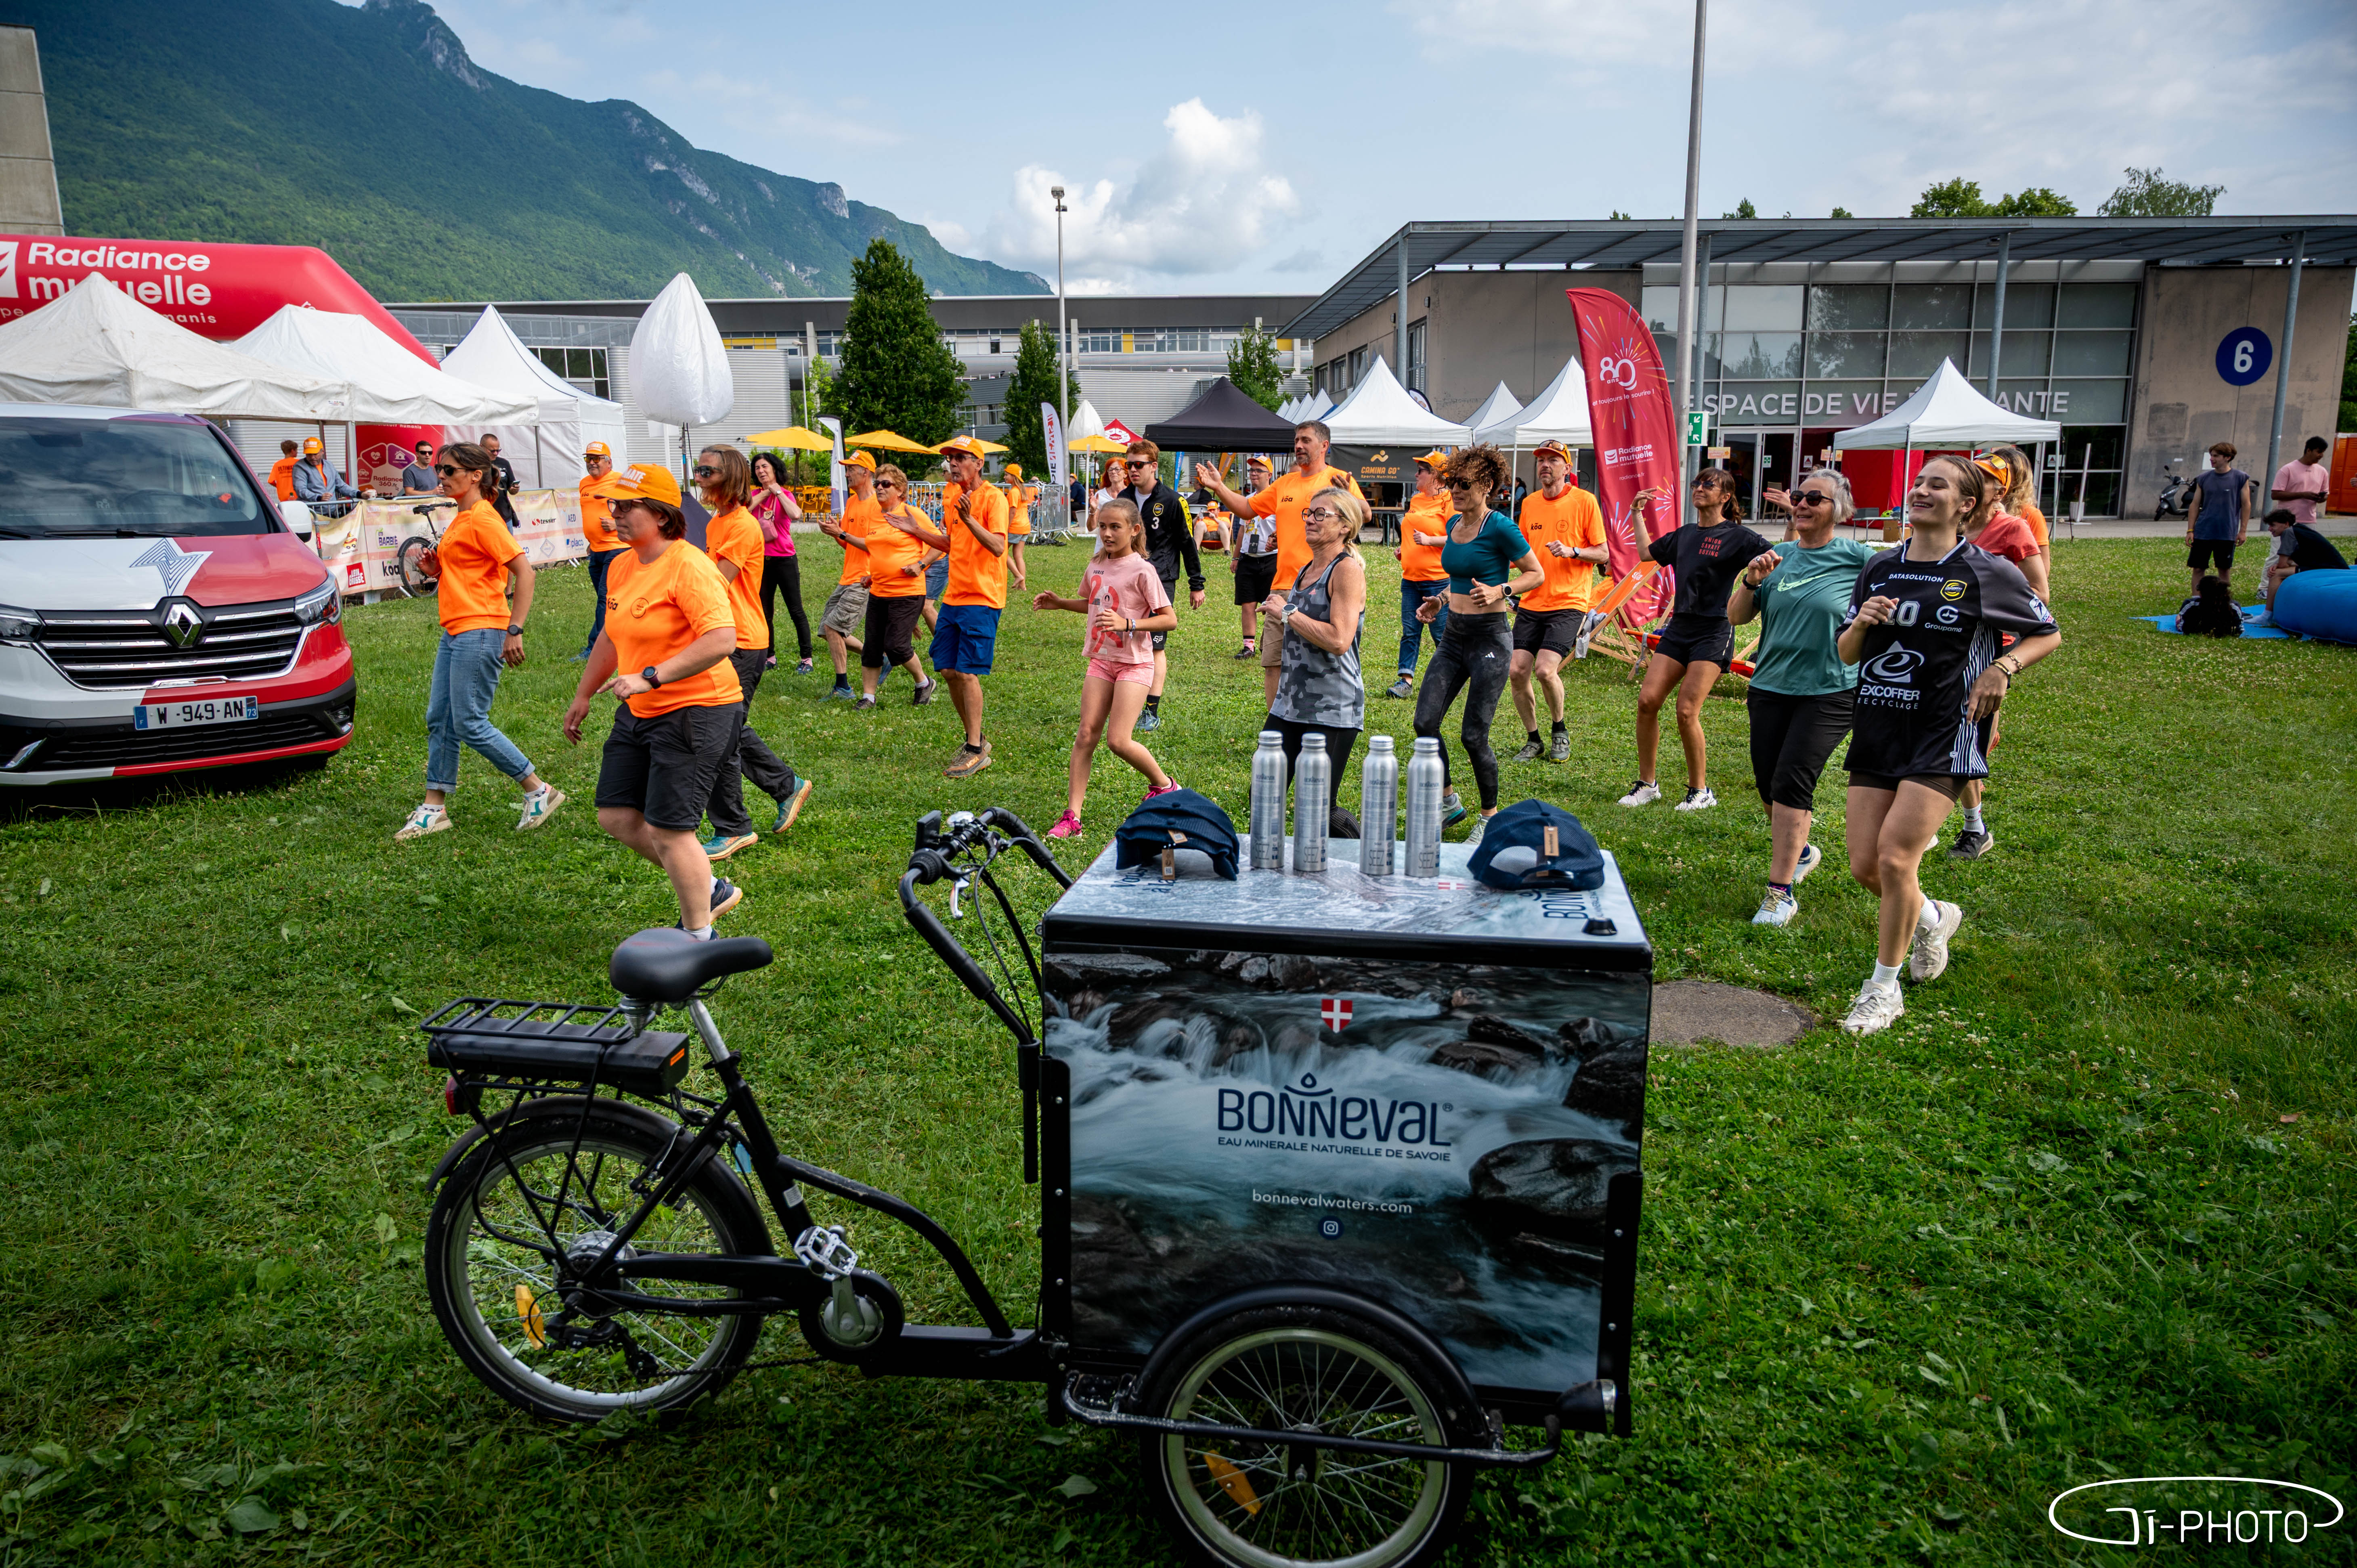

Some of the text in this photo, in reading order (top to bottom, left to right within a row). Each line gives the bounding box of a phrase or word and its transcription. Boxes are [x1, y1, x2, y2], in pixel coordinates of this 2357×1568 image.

[28, 243, 210, 271] Radiance
[2234, 340, 2254, 373] 6
[1600, 357, 1636, 387] 80
[1599, 396, 1622, 404] toujours
[1631, 390, 1651, 398] sourire
[1806, 394, 1843, 415] DE
[1852, 393, 1898, 415] VIE
[1618, 444, 1652, 455] Radiance
[1619, 451, 1653, 462] mutuelle
[1619, 472, 1645, 480] radiance.fr
[568, 514, 576, 522] AED
[1151, 517, 1160, 529] 3
[571, 539, 584, 547] placo
[1701, 543, 1720, 551] SAVATE
[1699, 549, 1718, 557] BOXING
[1888, 574, 1944, 583] DATASOLUTION
[1925, 622, 1962, 633] Groupama
[1860, 685, 1921, 701] EXCOFFIER
[1857, 698, 1919, 710] RECYCLAGE
[247, 709, 257, 717] 73
[1218, 1137, 1451, 1161] EAU MINERALE NATURELLE DE SAVOIE
[1253, 1189, 1412, 1214] bonnevalwaters.com
